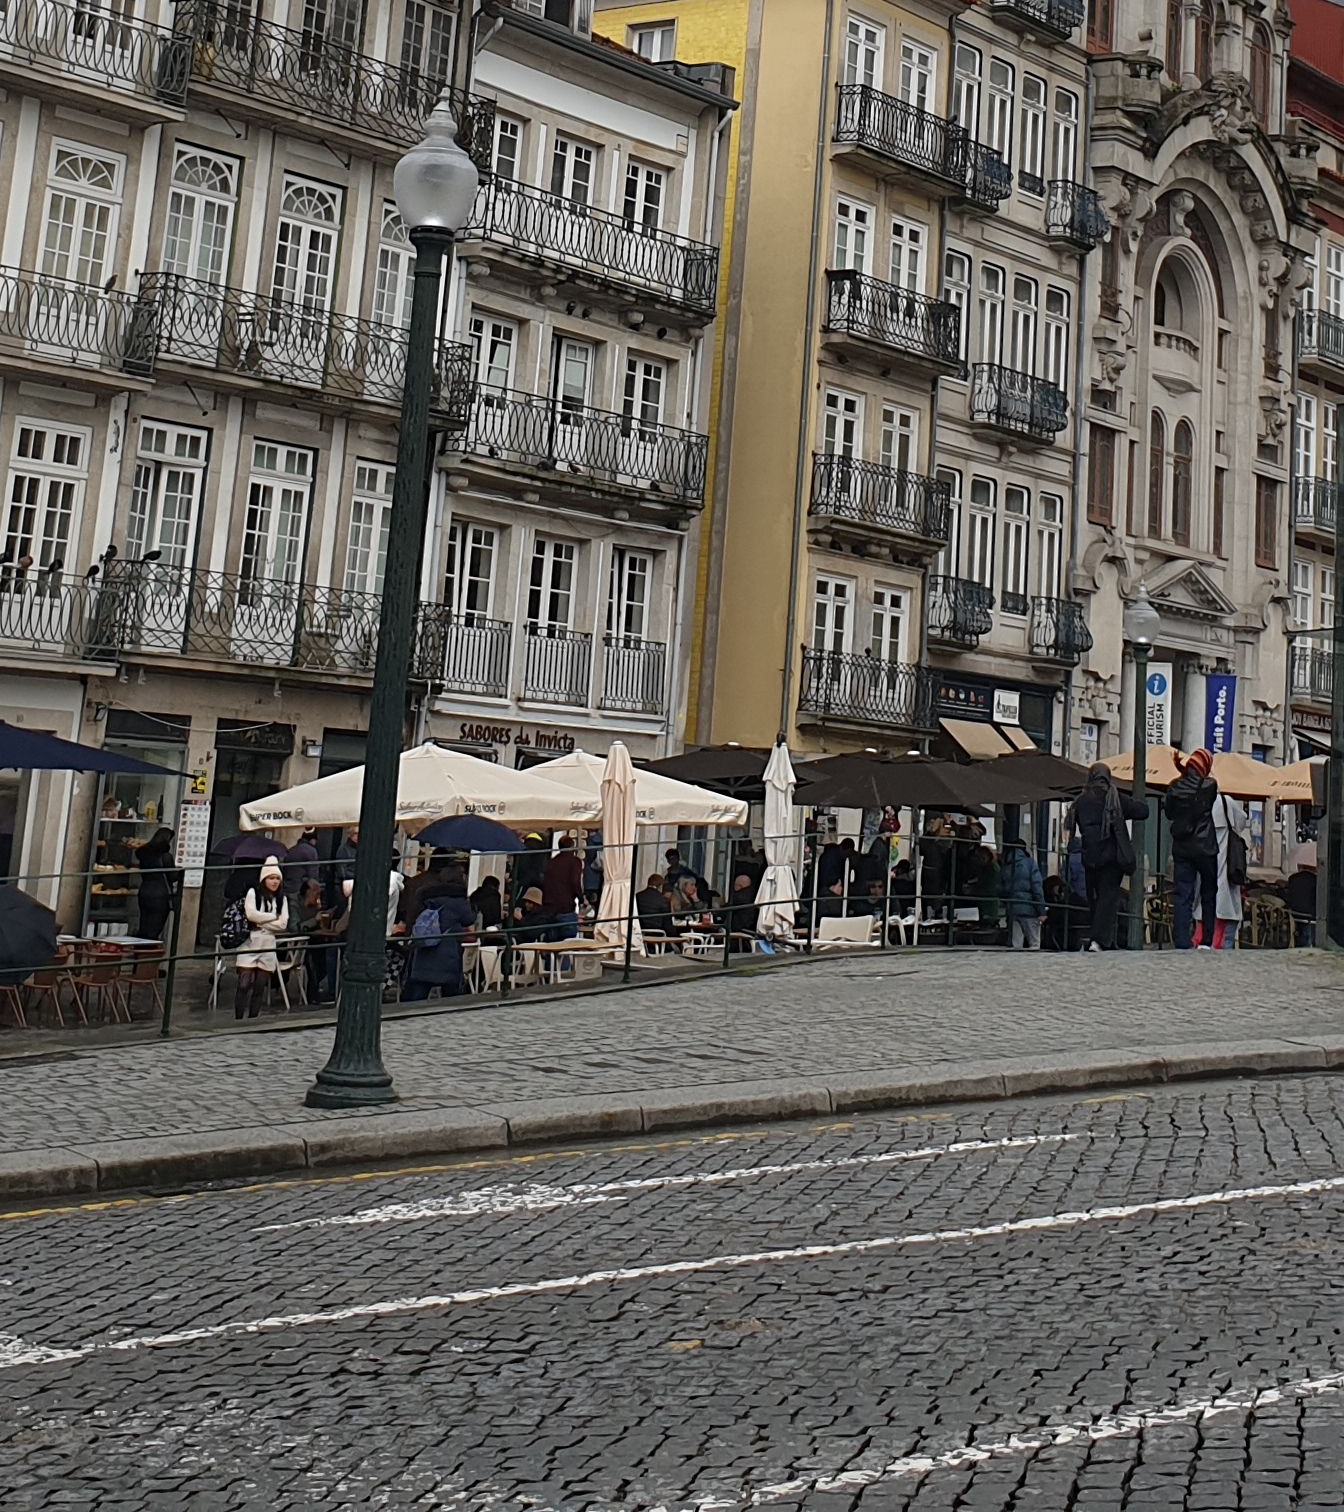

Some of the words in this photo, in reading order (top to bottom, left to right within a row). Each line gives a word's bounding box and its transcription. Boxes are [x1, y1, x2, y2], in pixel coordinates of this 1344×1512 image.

[459, 723, 512, 745] SABORES
[535, 730, 575, 751] Invicta
[1147, 702, 1155, 745] FFICIAL
[1156, 703, 1164, 745] OURISM
